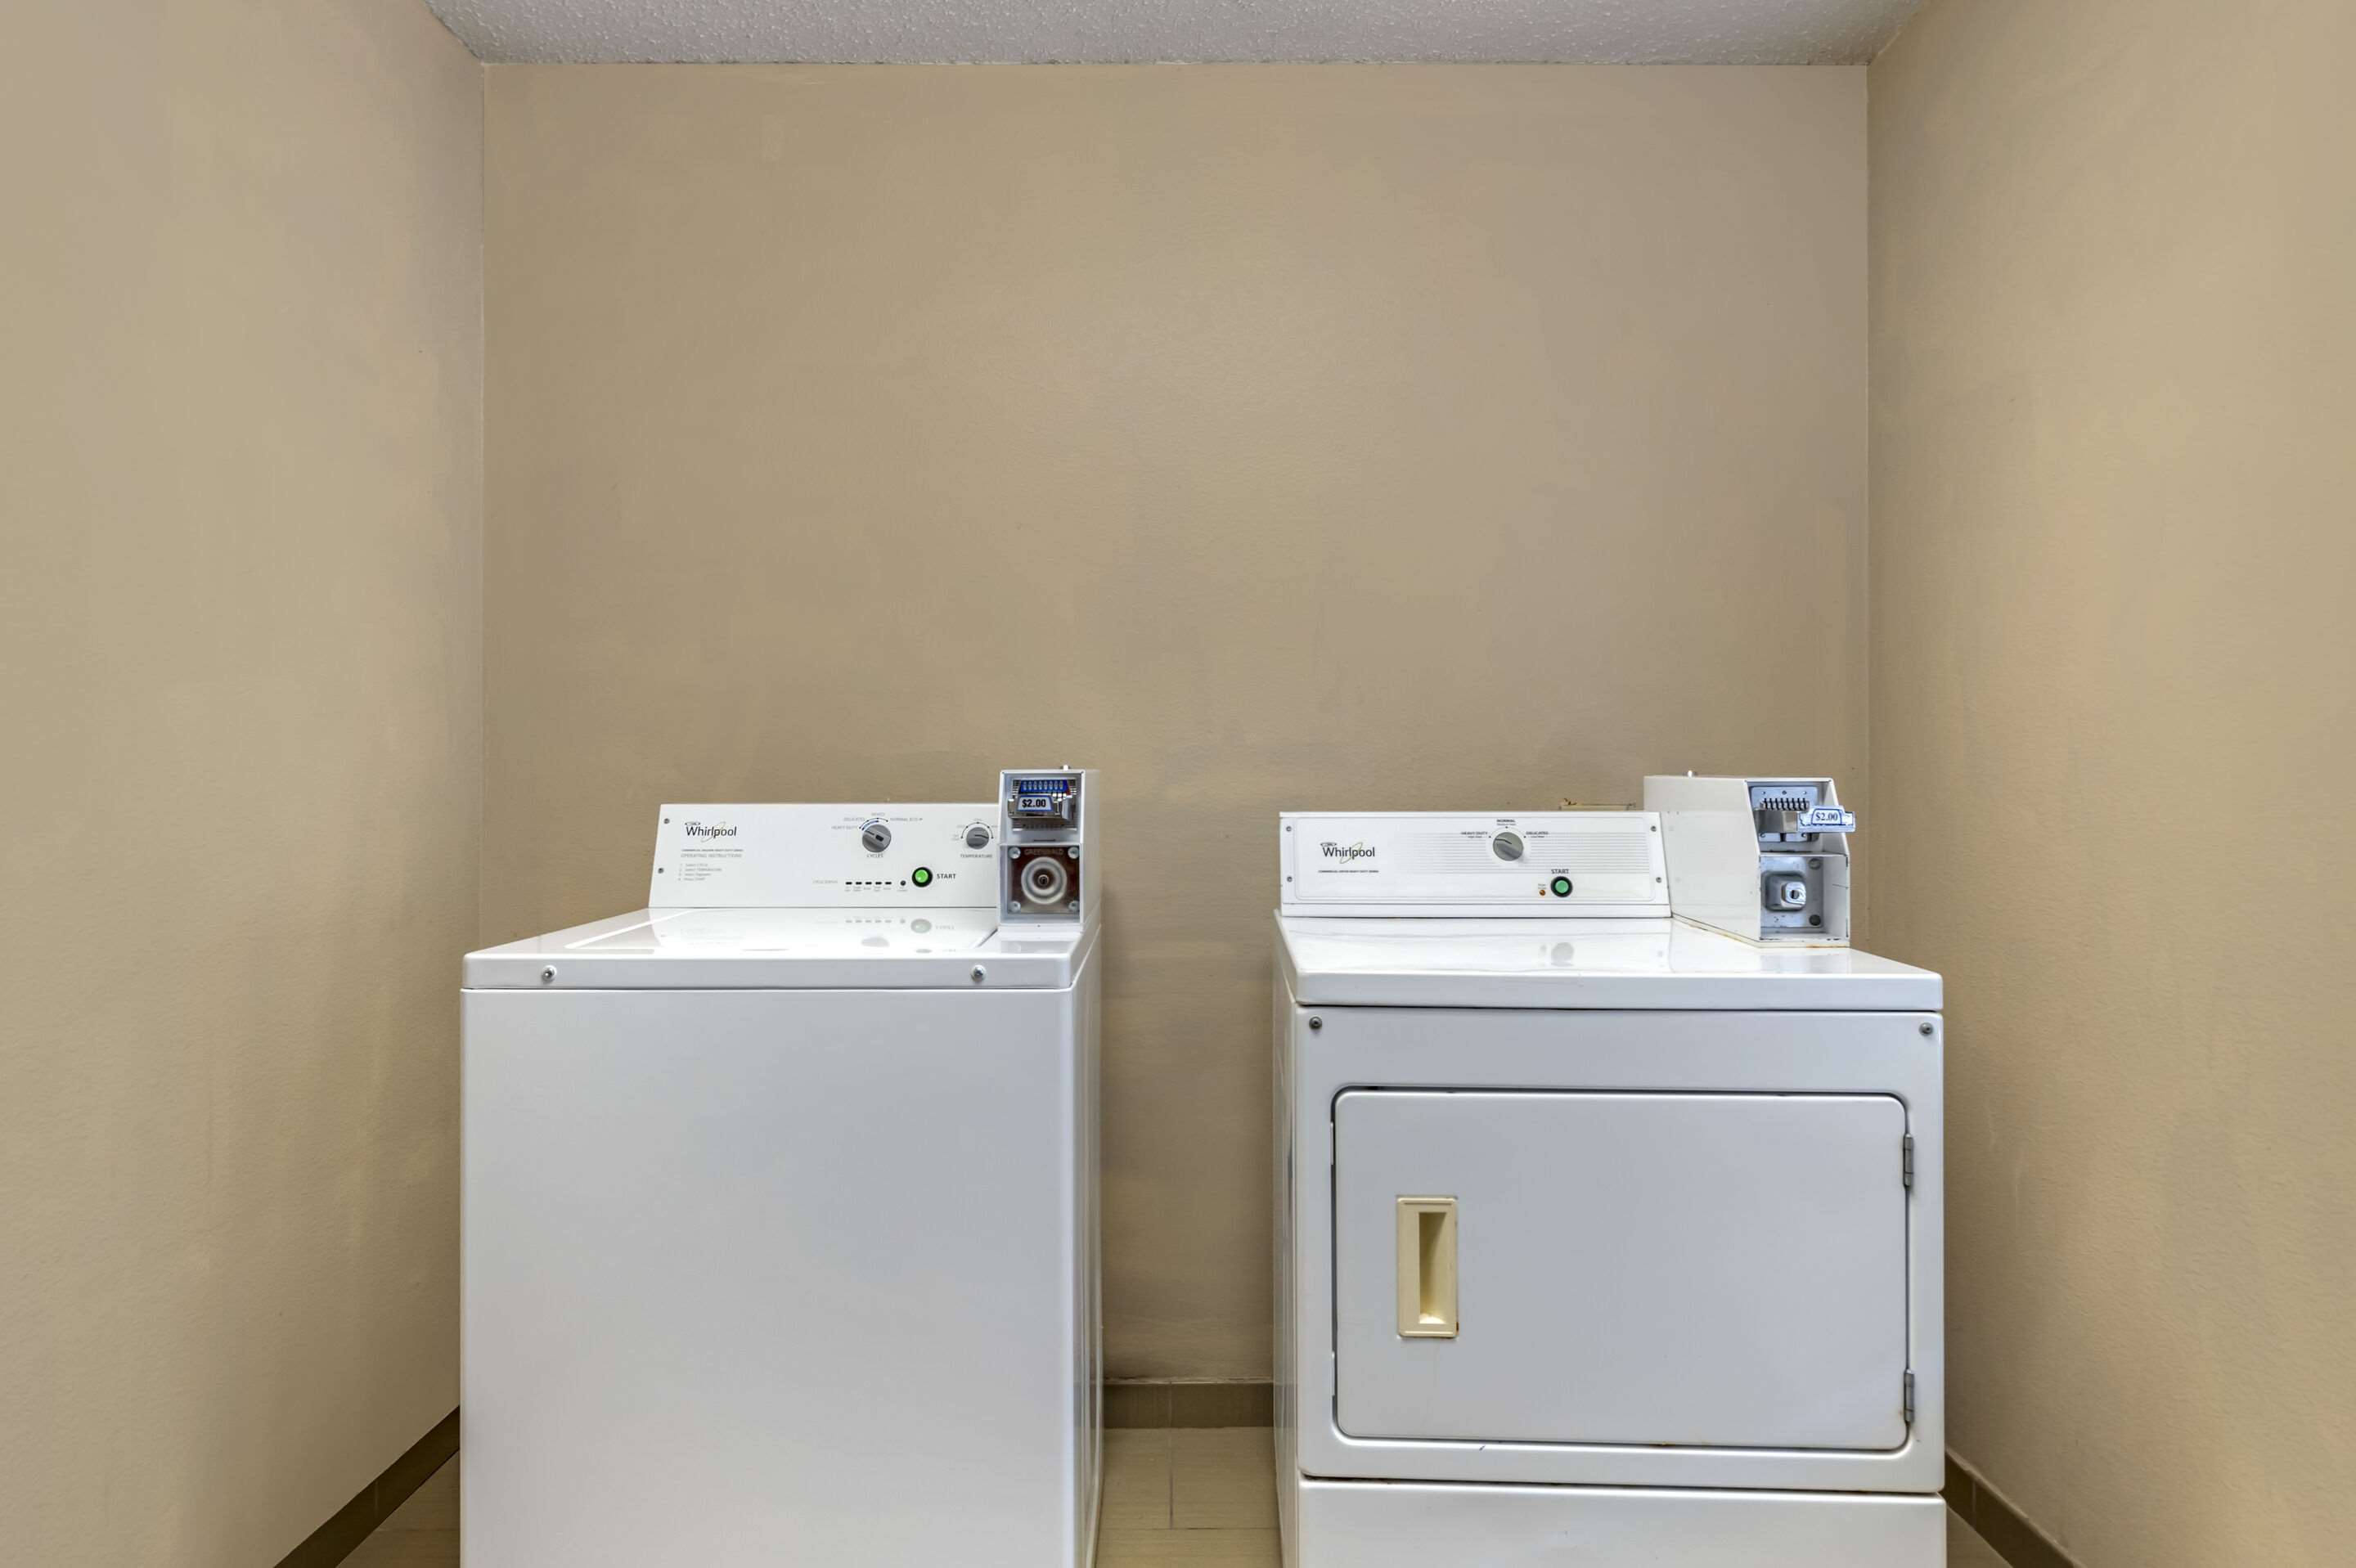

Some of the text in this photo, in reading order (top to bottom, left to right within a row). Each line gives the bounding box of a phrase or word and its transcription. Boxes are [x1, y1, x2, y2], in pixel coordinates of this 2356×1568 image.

[1022, 798, 1046, 808] $2.00
[1815, 812, 1838, 821] $2.00
[686, 826, 737, 838] Whirlpool
[1322, 847, 1375, 860] Whirlpool
